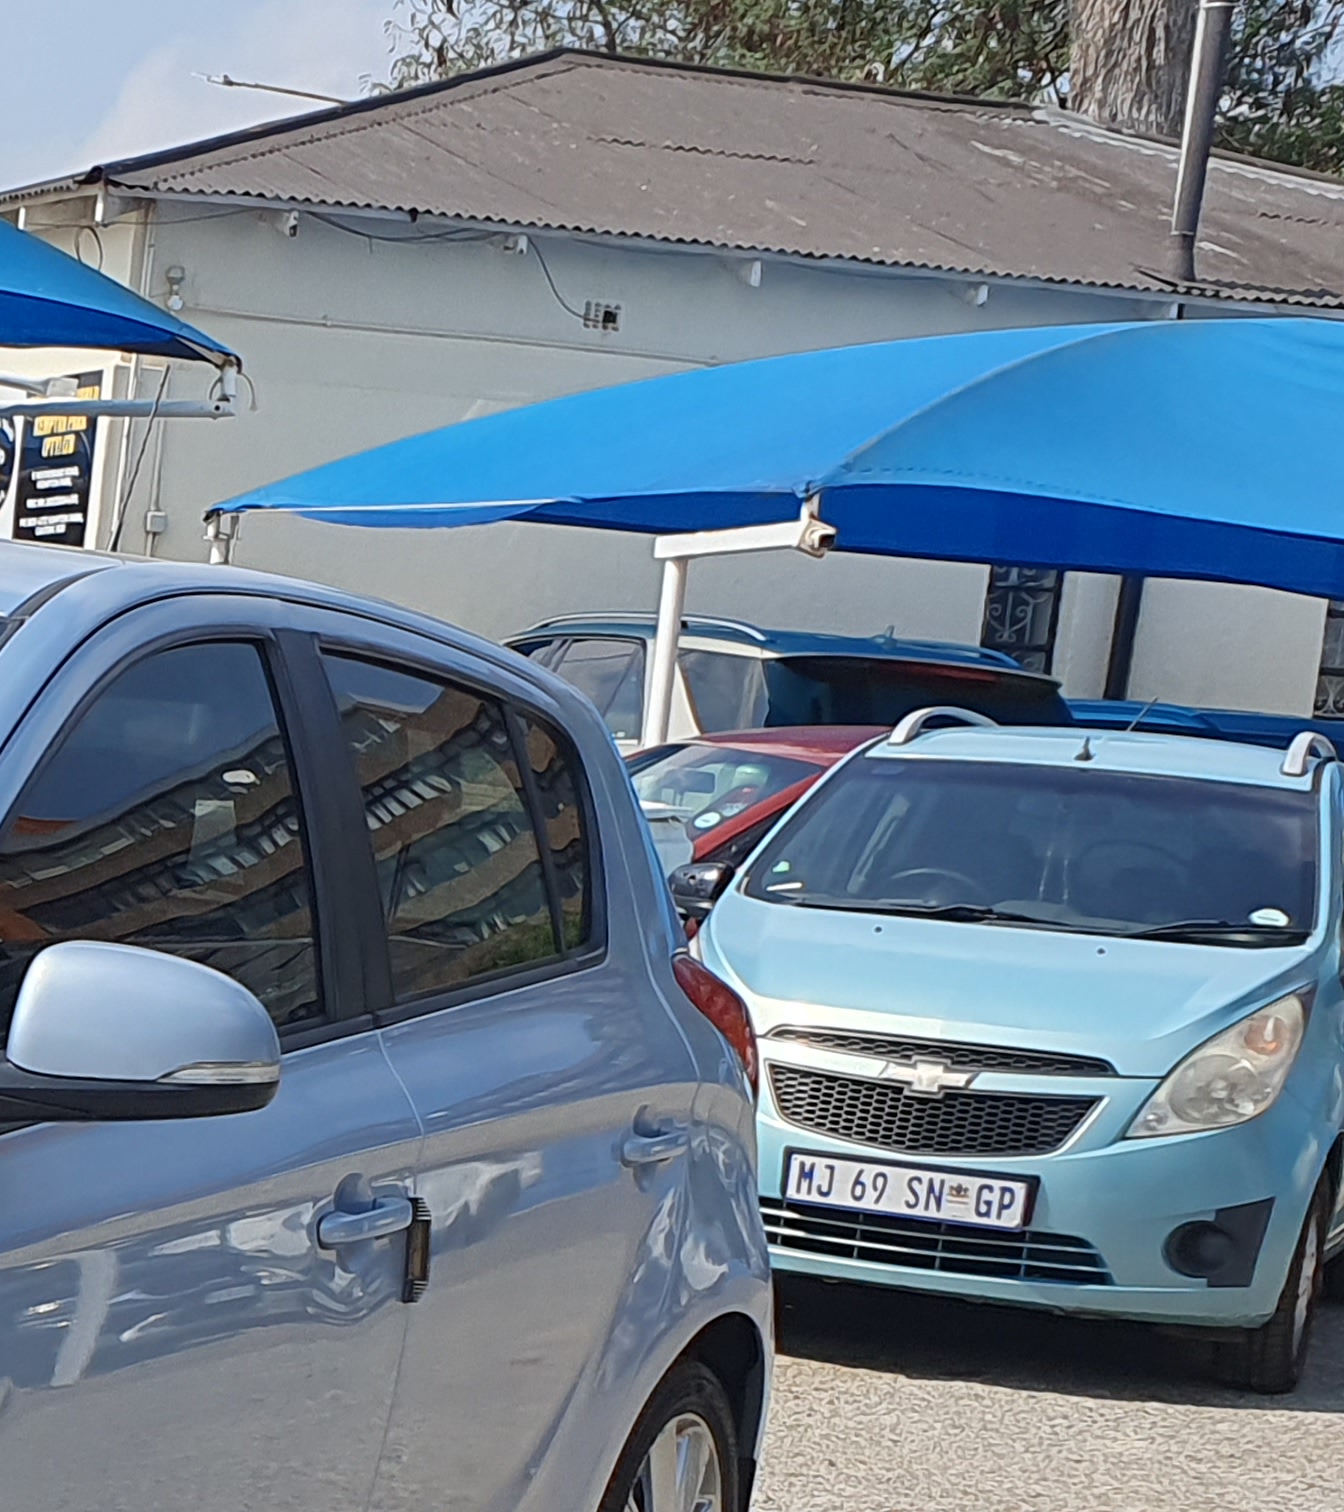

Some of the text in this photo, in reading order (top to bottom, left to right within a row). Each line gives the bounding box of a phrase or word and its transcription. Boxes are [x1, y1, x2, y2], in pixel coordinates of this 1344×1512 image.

[796, 1160, 1015, 1221] MJ 69 SN GP
